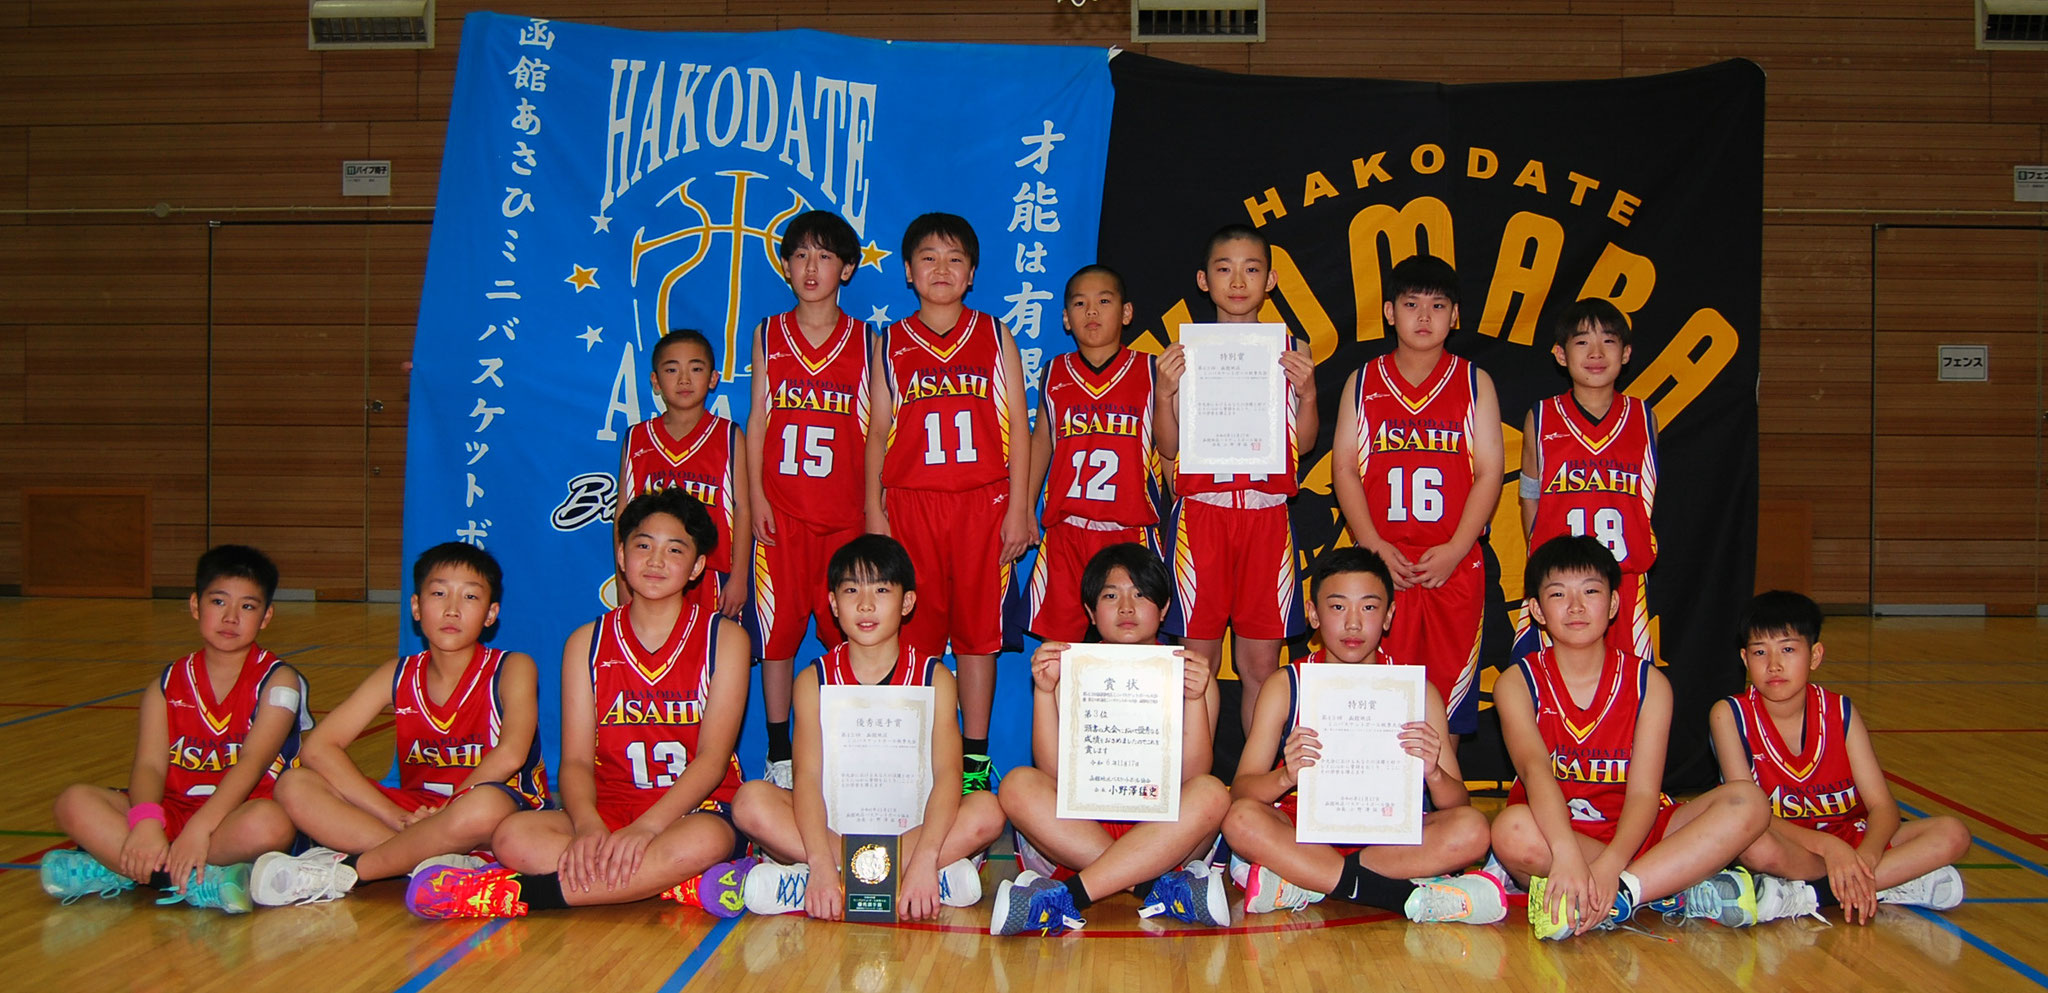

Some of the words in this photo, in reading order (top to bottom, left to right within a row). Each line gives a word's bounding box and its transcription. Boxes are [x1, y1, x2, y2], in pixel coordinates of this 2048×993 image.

[600, 59, 877, 239] HAKODATE
[1244, 143, 1642, 228] HAKODATE
[919, 366, 988, 376] HAKODATE
[1943, 357, 1983, 367] フェンス
[773, 379, 853, 415] ASAHI
[788, 378, 854, 391] HAKODATE
[903, 370, 989, 404] ASAHI
[925, 410, 978, 465] 11
[1057, 408, 1140, 439] ASAHI
[1370, 420, 1462, 454] ASAHI
[1387, 418, 1461, 429] HAKODATE
[779, 424, 835, 478] 15
[1568, 458, 1640, 471] HAKODATE
[1066, 449, 1119, 501] 12
[1543, 461, 1640, 496] ASAHI
[1387, 466, 1444, 522] 16
[1567, 508, 1628, 562] 18
[600, 690, 700, 725] ASAHI
[1348, 700, 1377, 710] 特別賞
[626, 741, 688, 789] 13
[1550, 749, 1630, 785] ASAHI
[1768, 785, 1858, 819] ASAHI
